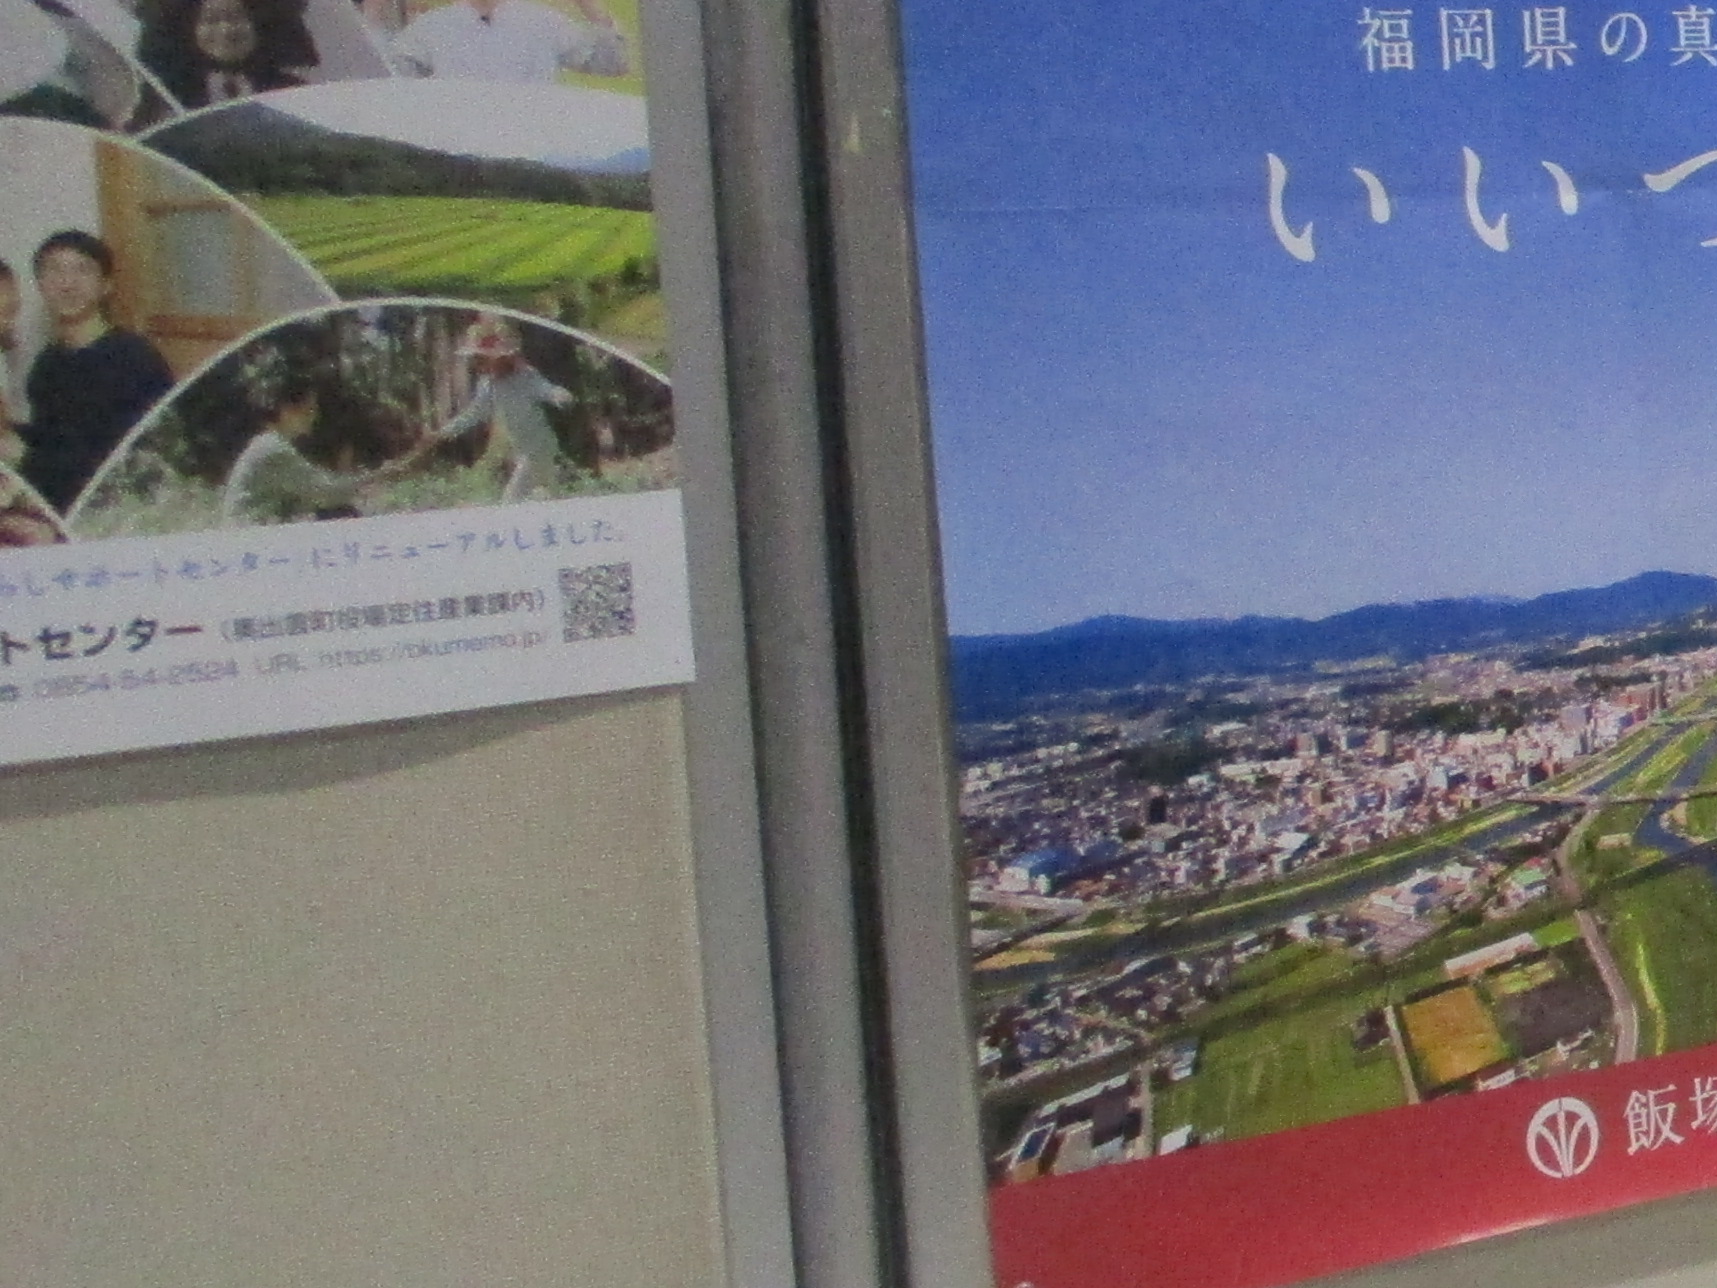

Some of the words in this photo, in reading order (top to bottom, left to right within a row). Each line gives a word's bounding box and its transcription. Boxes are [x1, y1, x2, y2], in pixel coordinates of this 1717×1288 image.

[0, 615, 204, 664] トセンター
